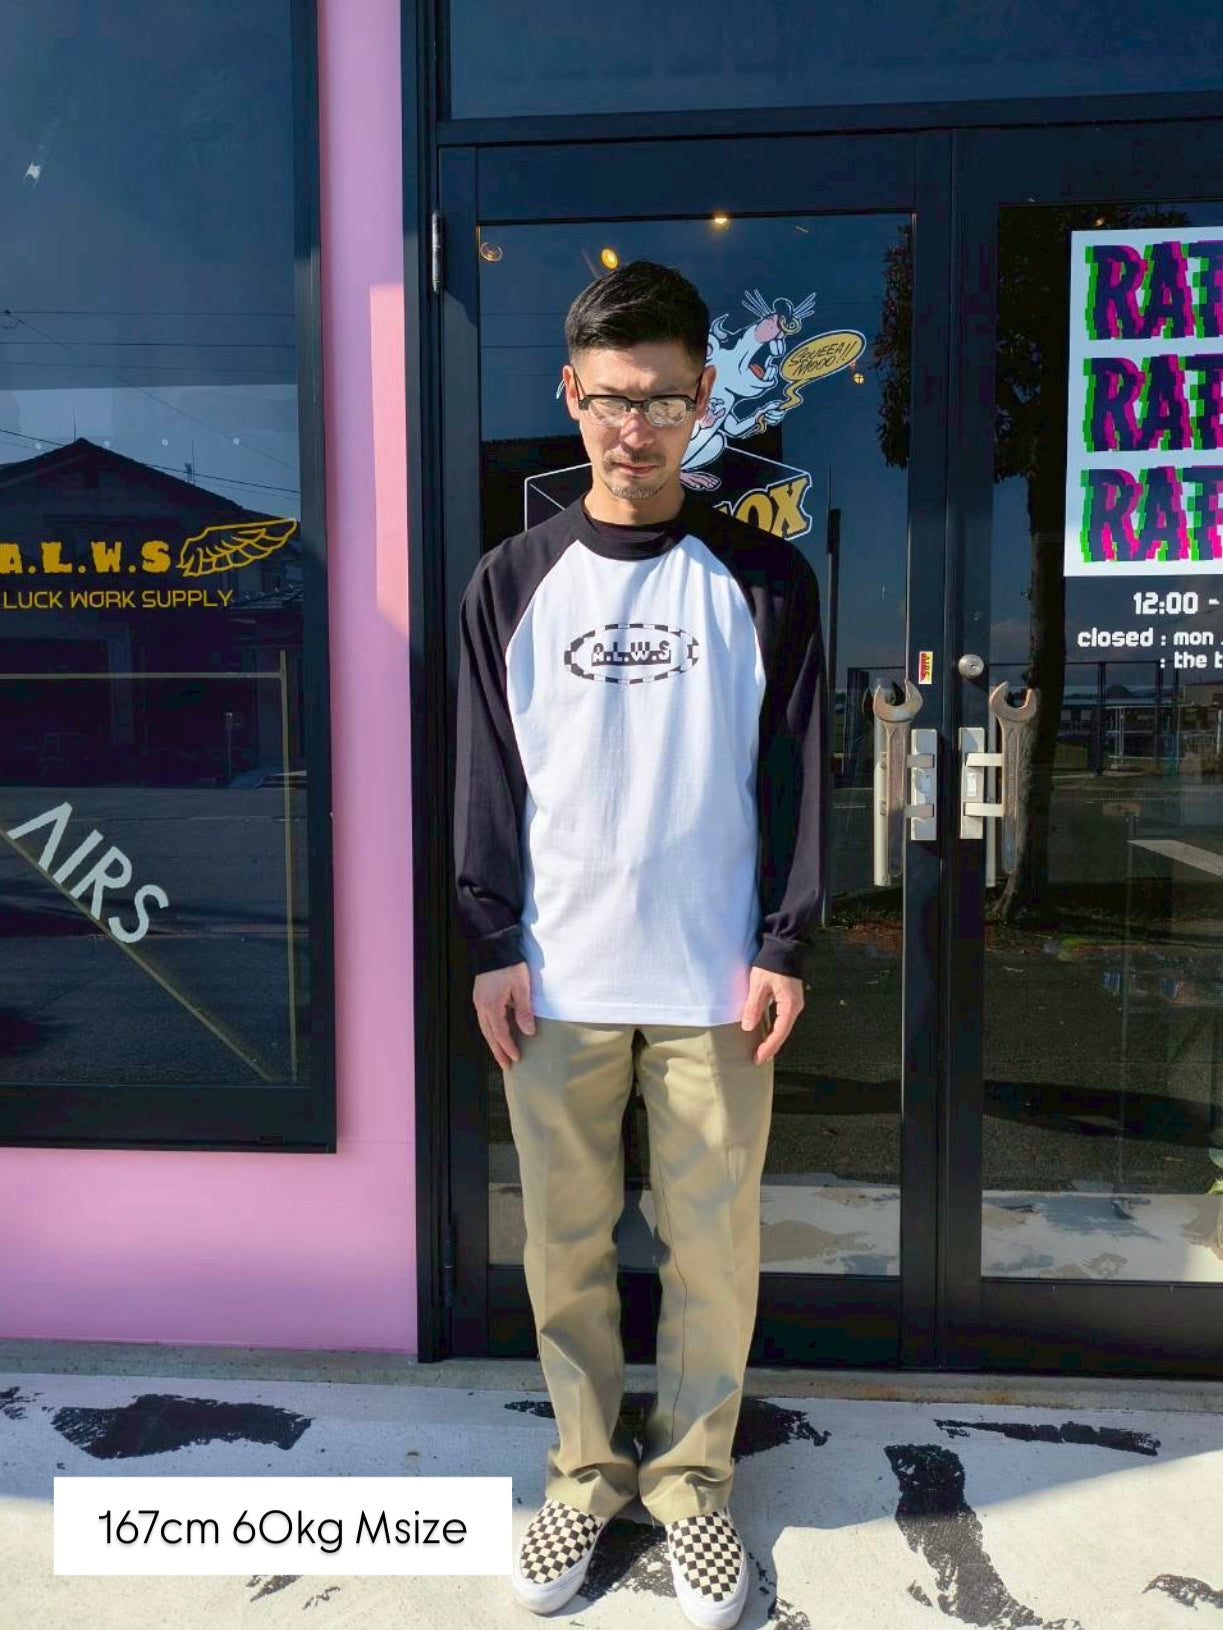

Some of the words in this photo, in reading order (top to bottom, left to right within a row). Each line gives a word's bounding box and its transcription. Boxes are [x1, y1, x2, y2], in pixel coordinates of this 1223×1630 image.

[3, 591, 63, 610] LUCK
[70, 590, 136, 609] WORK
[142, 590, 234, 608] SUPPLY
[1133, 591, 1199, 615] 12:00
[1077, 627, 1154, 647] closed
[1173, 631, 1214, 645] mon
[1173, 651, 1208, 669] the
